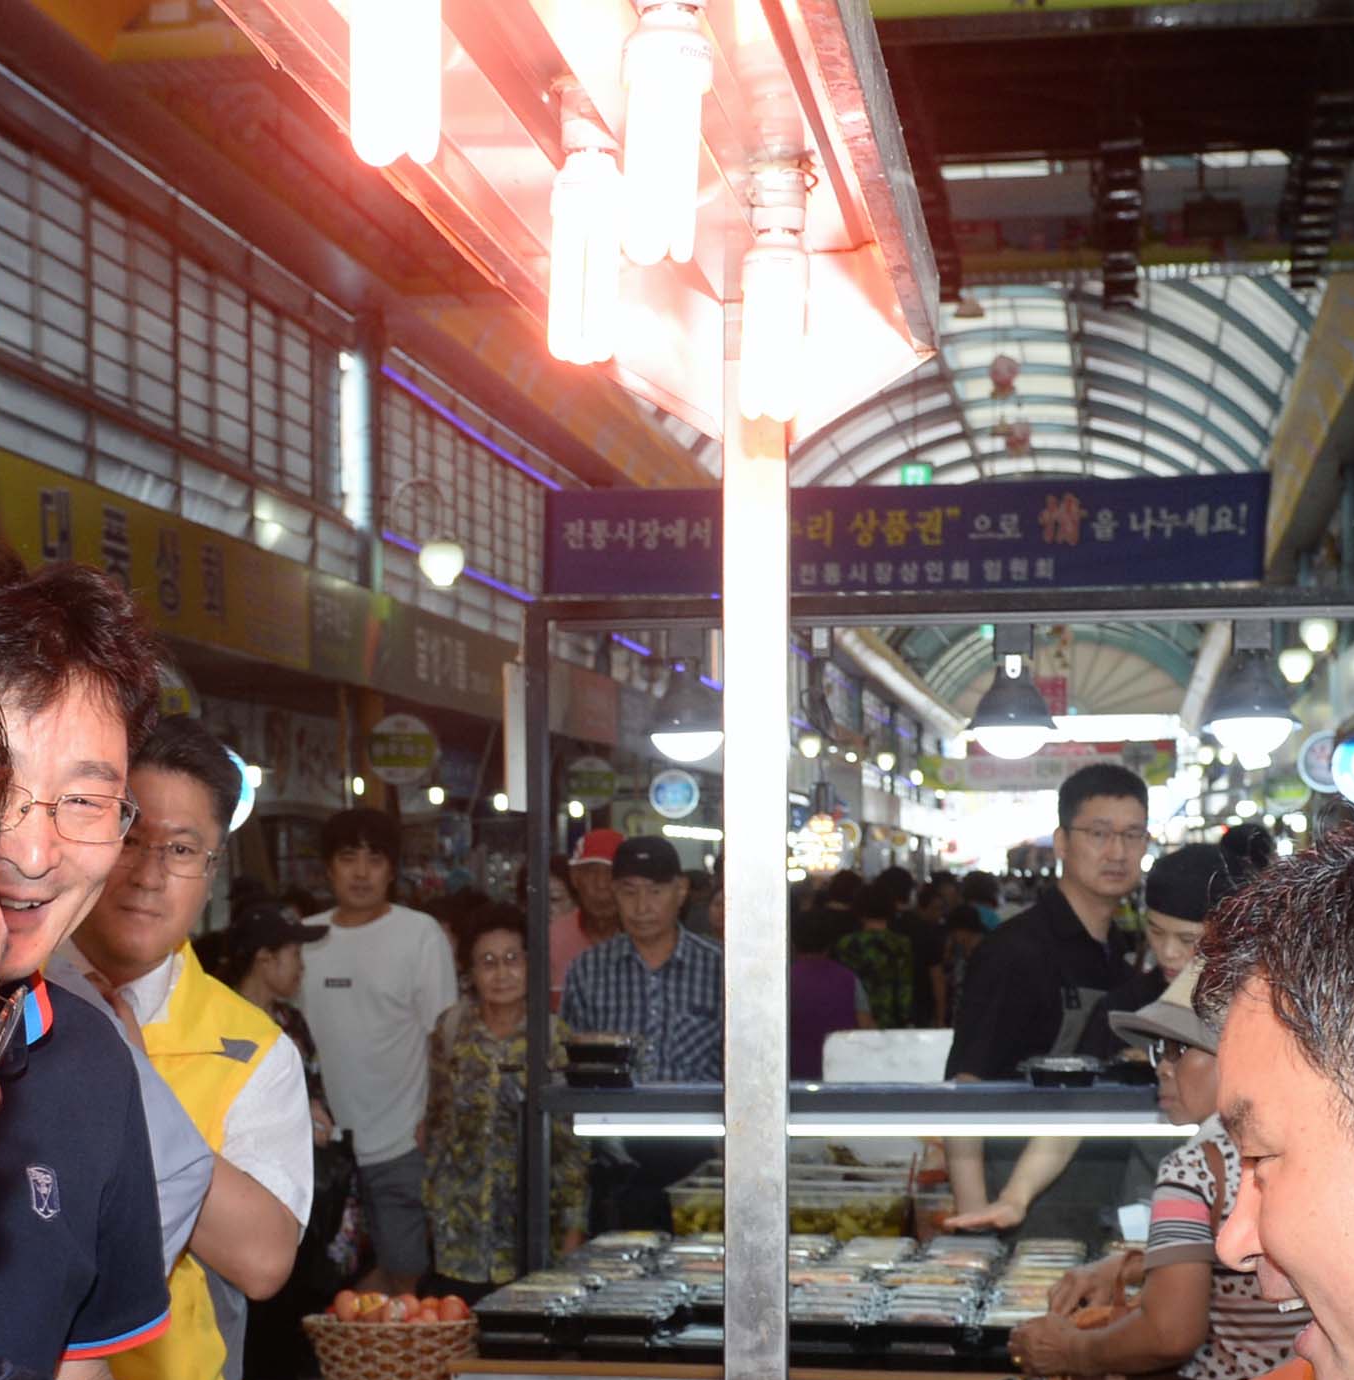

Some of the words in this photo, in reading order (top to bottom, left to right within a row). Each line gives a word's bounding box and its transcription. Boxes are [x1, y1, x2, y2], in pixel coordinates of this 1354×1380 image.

[562, 517, 713, 551] 전통시장에서
[790, 508, 835, 549] 리
[968, 512, 1023, 540] 으로
[1128, 501, 1249, 541] 나누세요!
